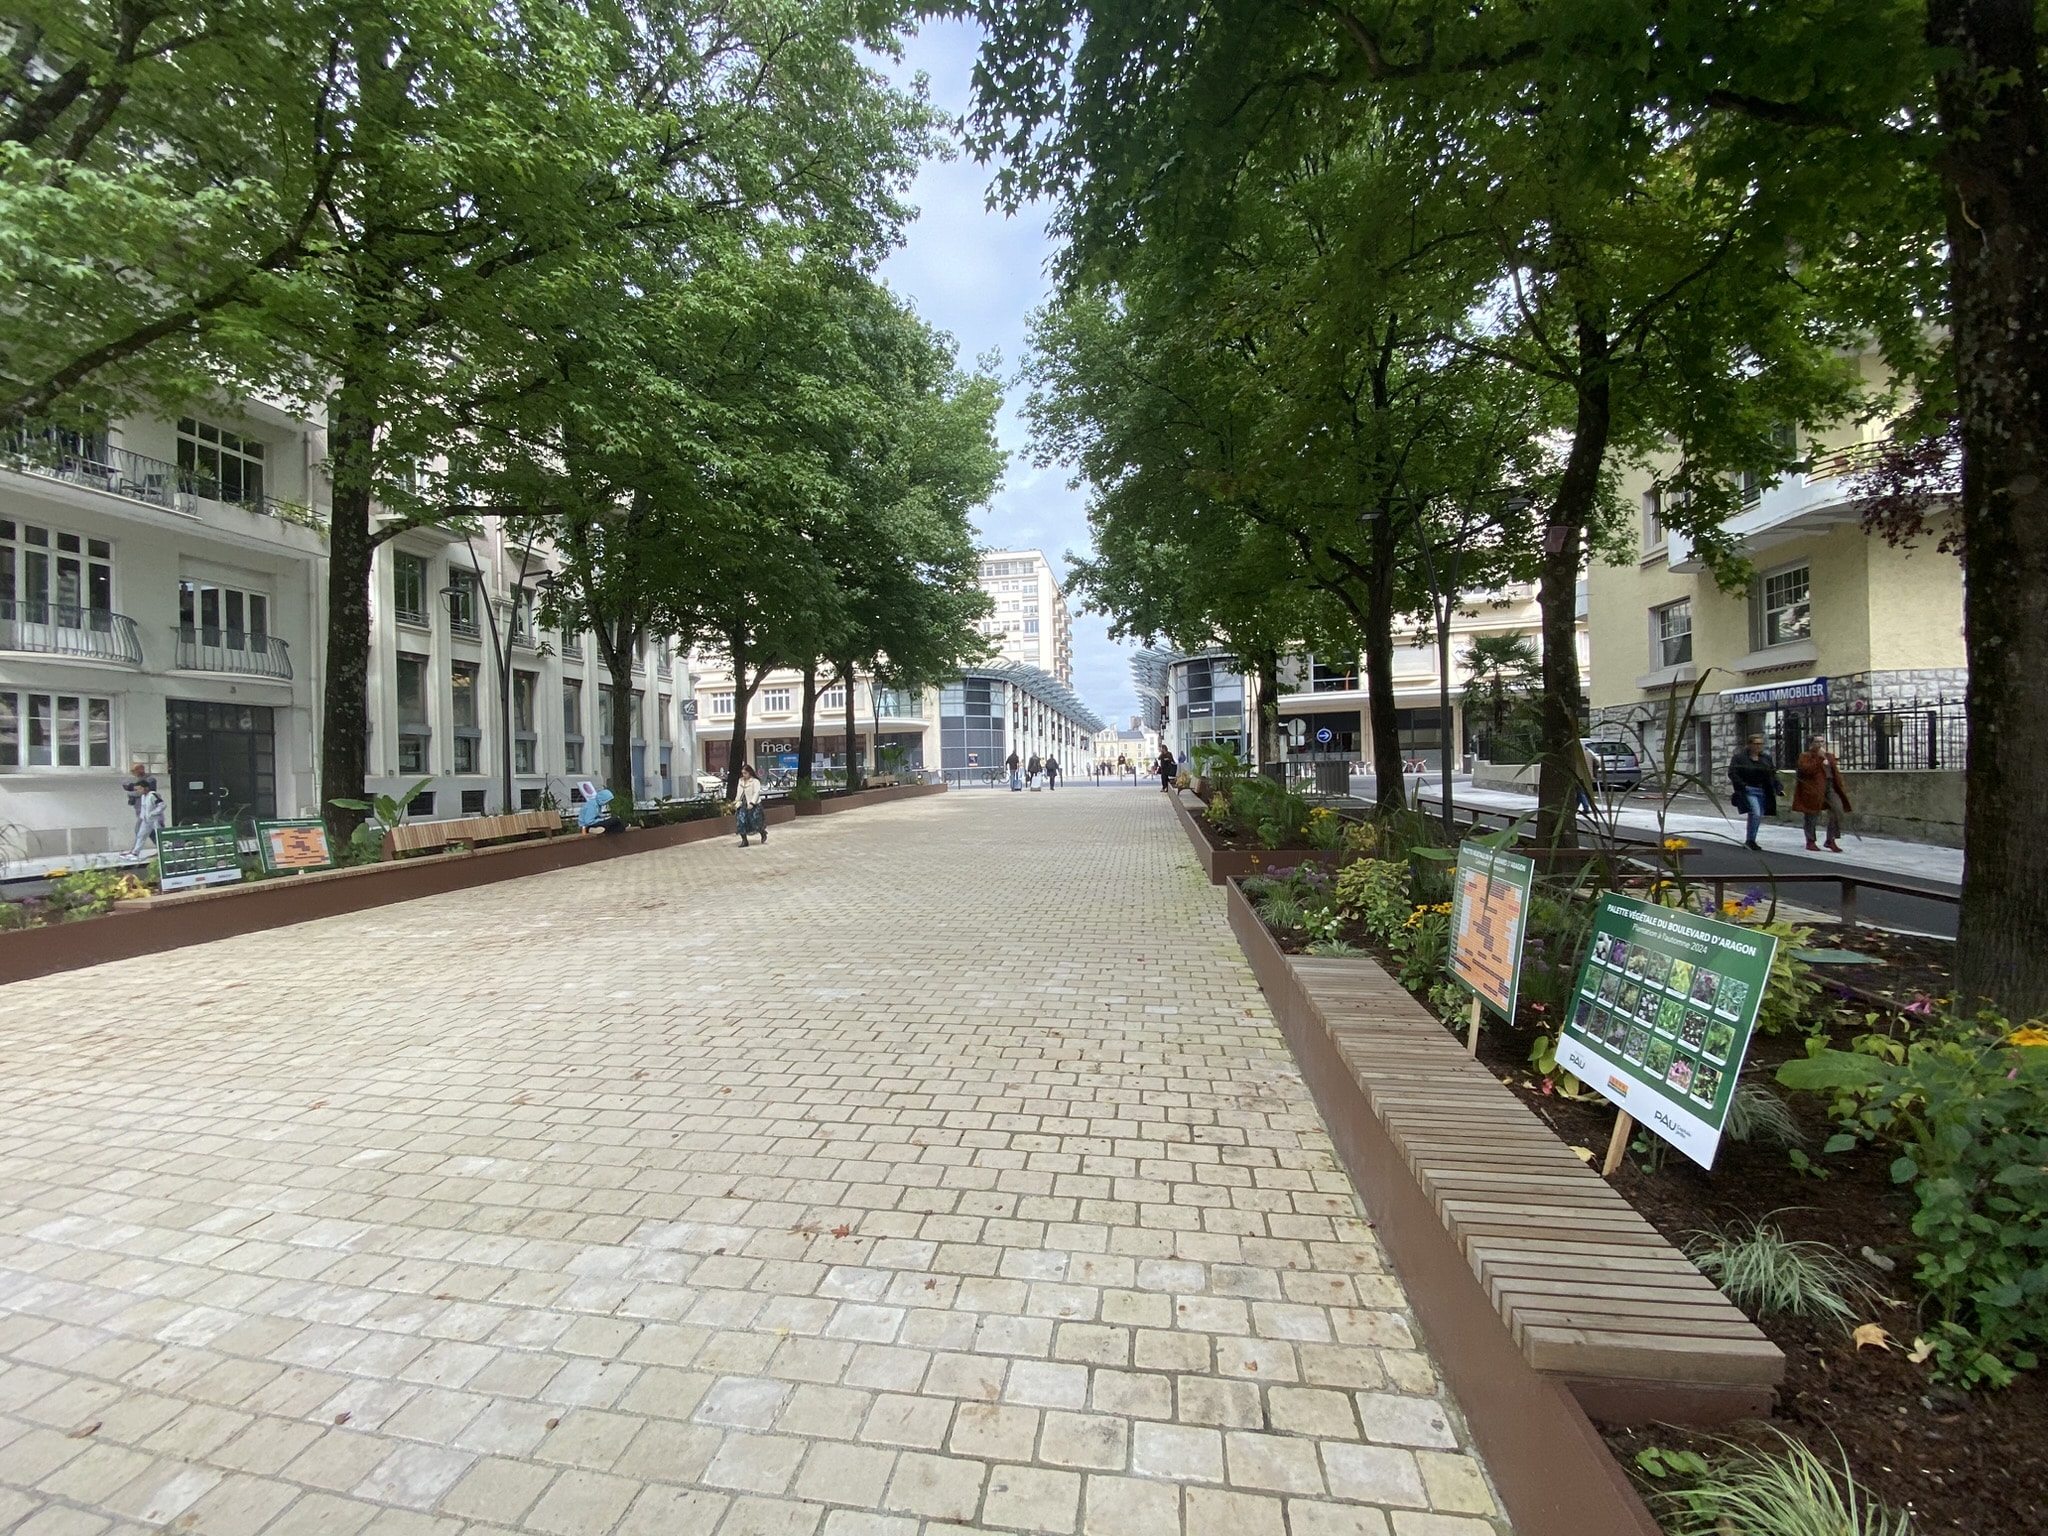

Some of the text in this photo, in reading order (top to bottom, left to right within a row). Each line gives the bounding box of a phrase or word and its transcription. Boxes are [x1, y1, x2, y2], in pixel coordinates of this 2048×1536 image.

[1733, 690, 1768, 705] ARAGON
[1769, 684, 1824, 701] IMMOBILIER
[761, 741, 792, 752] fnac
[1607, 904, 1757, 956] PALETTE VÉGÉTALE DU BOULEVARD D'ARAGON
[1691, 941, 1708, 955] 2024
[1569, 1053, 1586, 1069] PAU
[1654, 1110, 1677, 1131] PAU
